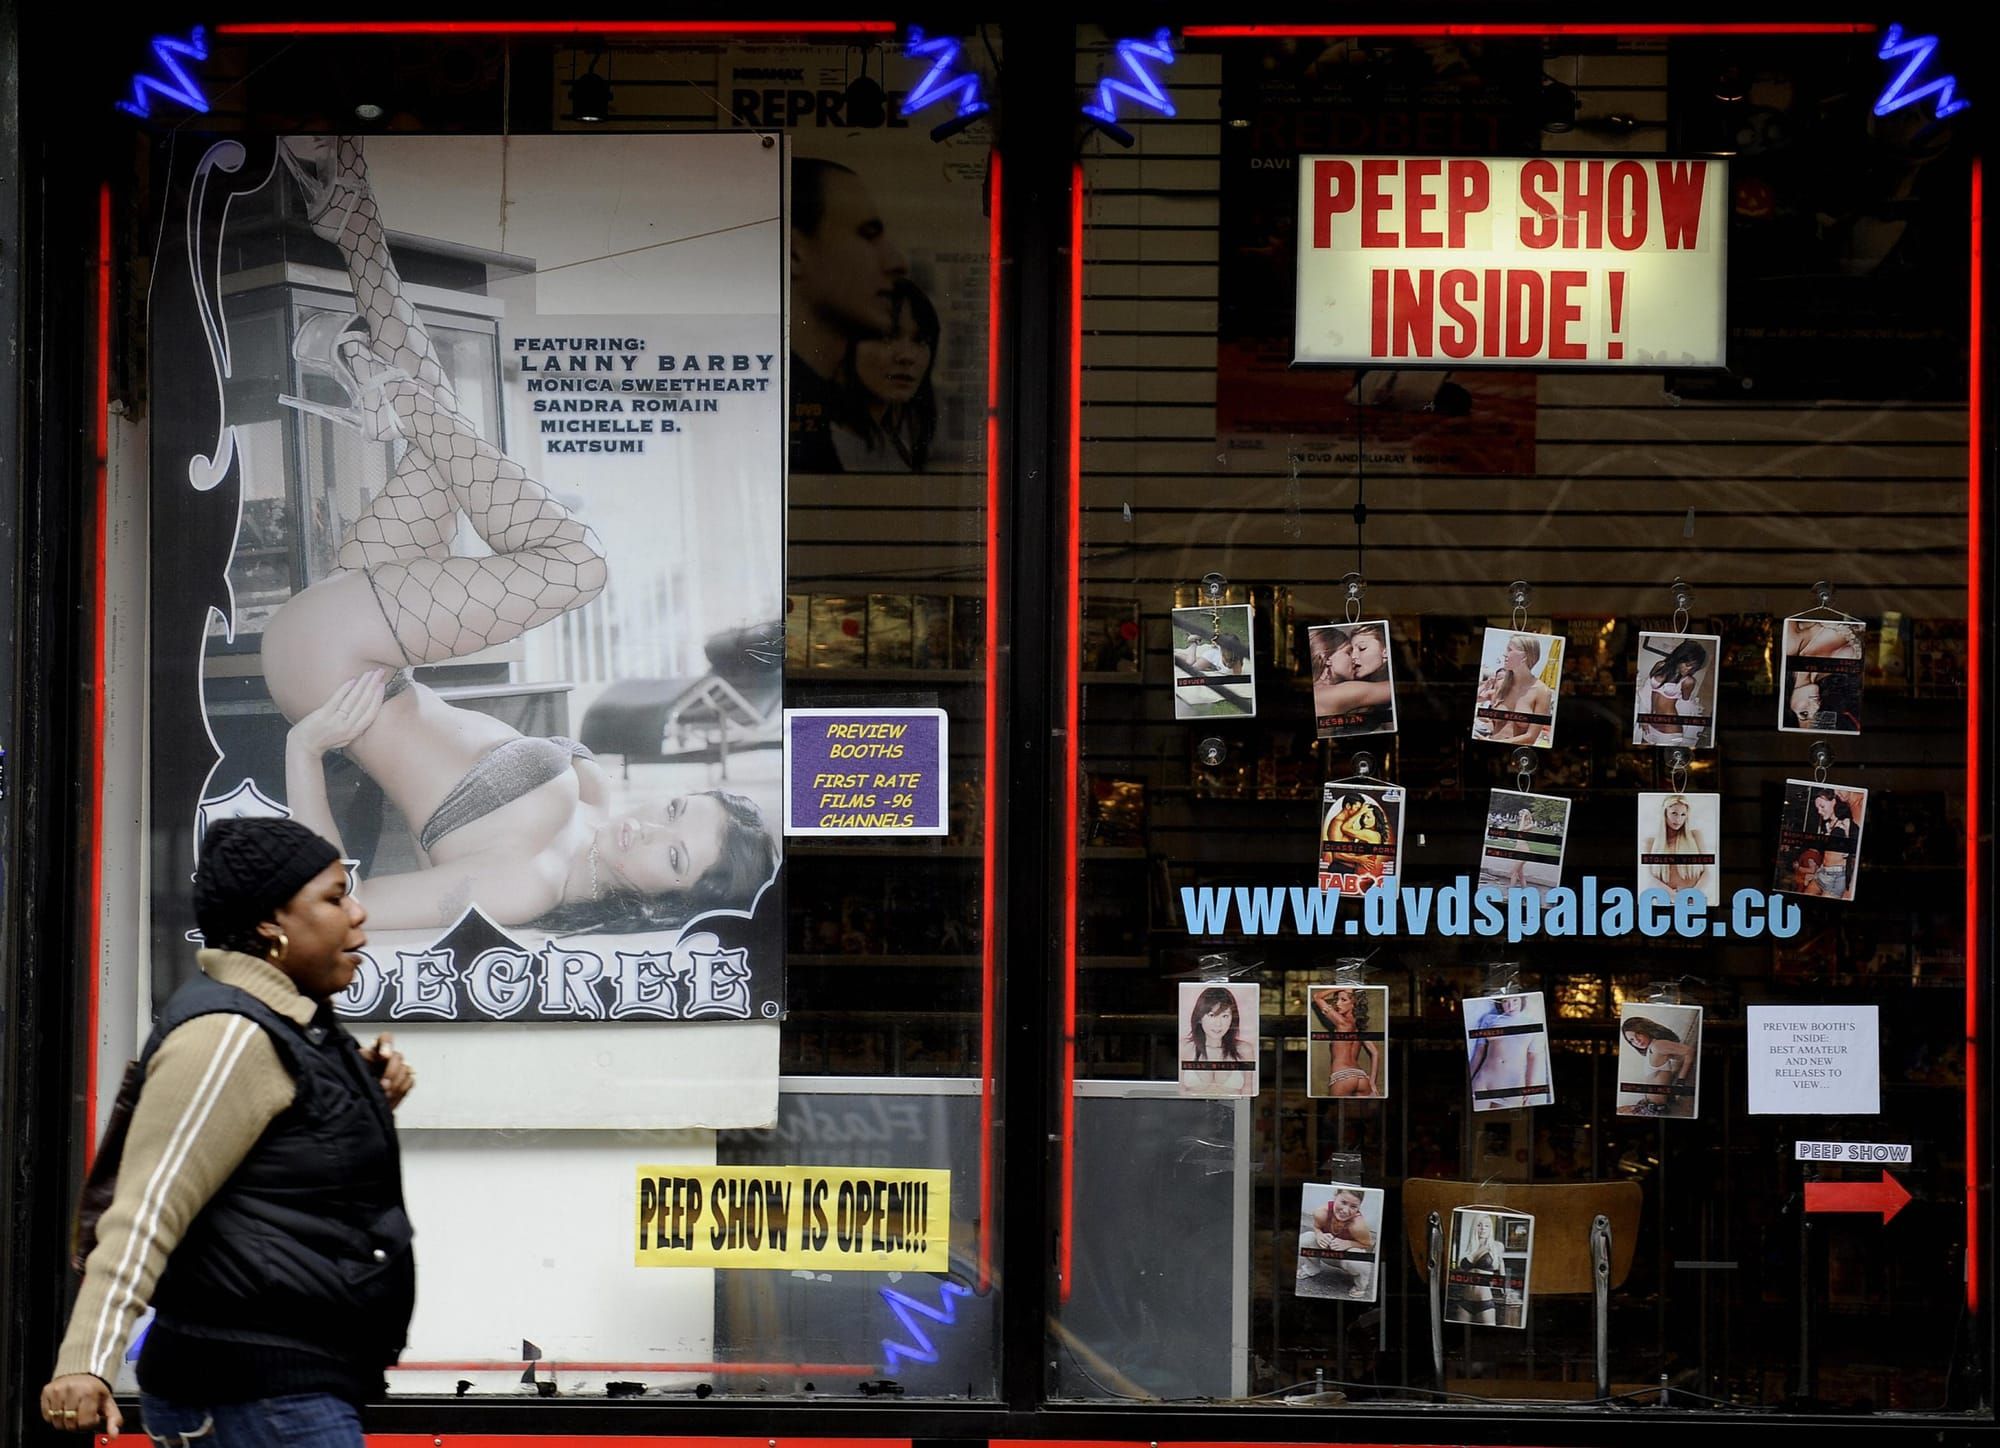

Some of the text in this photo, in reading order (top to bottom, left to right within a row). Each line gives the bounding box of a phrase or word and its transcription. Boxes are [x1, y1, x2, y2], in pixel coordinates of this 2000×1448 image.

[732, 89, 908, 127] REPRE
[1313, 159, 1707, 251] PEEP SHOW
[514, 338, 646, 351] FEATURING:
[520, 355, 774, 371] LANNY BARBY
[527, 378, 770, 392] MONICA SWEETHEART
[533, 399, 718, 412] SANDRA ROMAIN
[540, 420, 682, 433] MICHELLE B.
[547, 440, 644, 453] KATSUMI
[826, 723, 907, 739] PREVIEW
[830, 744, 904, 759] BOOTHS
[813, 773, 921, 788] FIRST RATE
[819, 794, 876, 809] FILMS
[819, 813, 914, 828] CHANNELS
[1763, 1022, 1856, 1032] PREVIEW BOOTH'S
[1792, 1033, 1829, 1043] INSIDE:
[1769, 1045, 1848, 1055] BEST AMATEUR
[1785, 1057, 1832, 1066] AND NEW
[1775, 1068, 1842, 1078] RELEASES TO
[1799, 1142, 1909, 1161] PEEP SHOW
[639, 1177, 929, 1254] PEEP SHOW IS OPEN!!!
